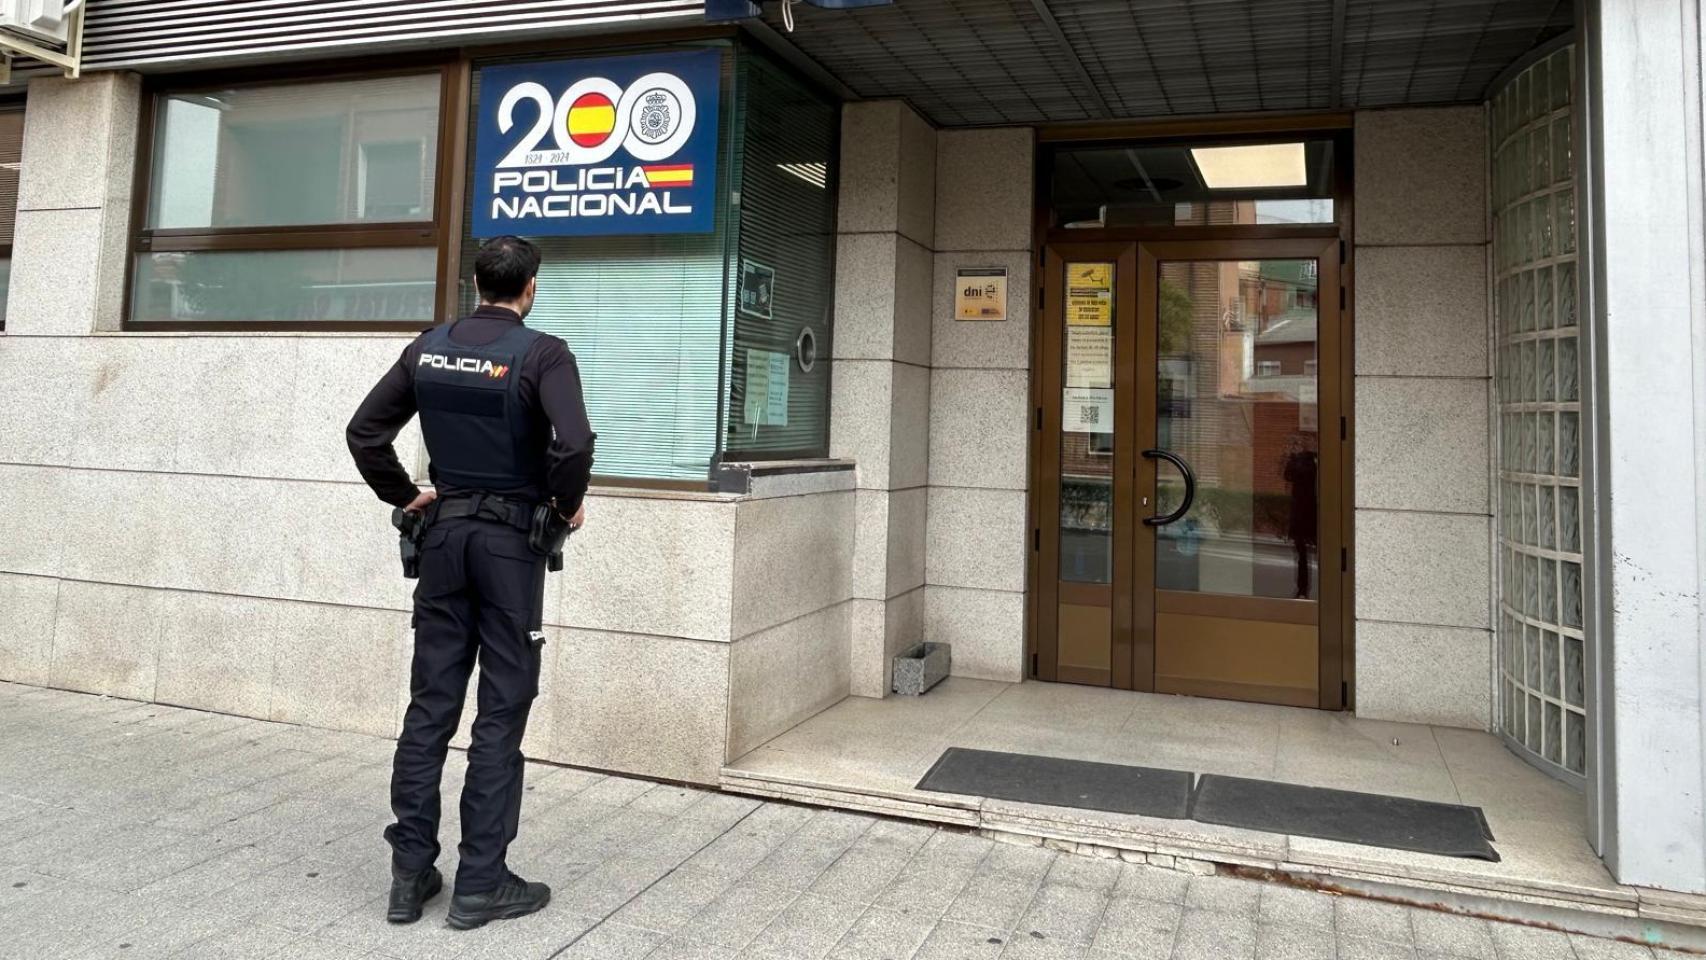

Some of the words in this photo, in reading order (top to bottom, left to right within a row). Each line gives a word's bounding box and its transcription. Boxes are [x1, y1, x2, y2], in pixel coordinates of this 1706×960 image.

[495, 72, 696, 168] 200
[550, 151, 570, 164] 2024
[492, 191, 693, 219] NACIONAL
[964, 285, 982, 297] dni
[418, 353, 495, 377] POLICIA
